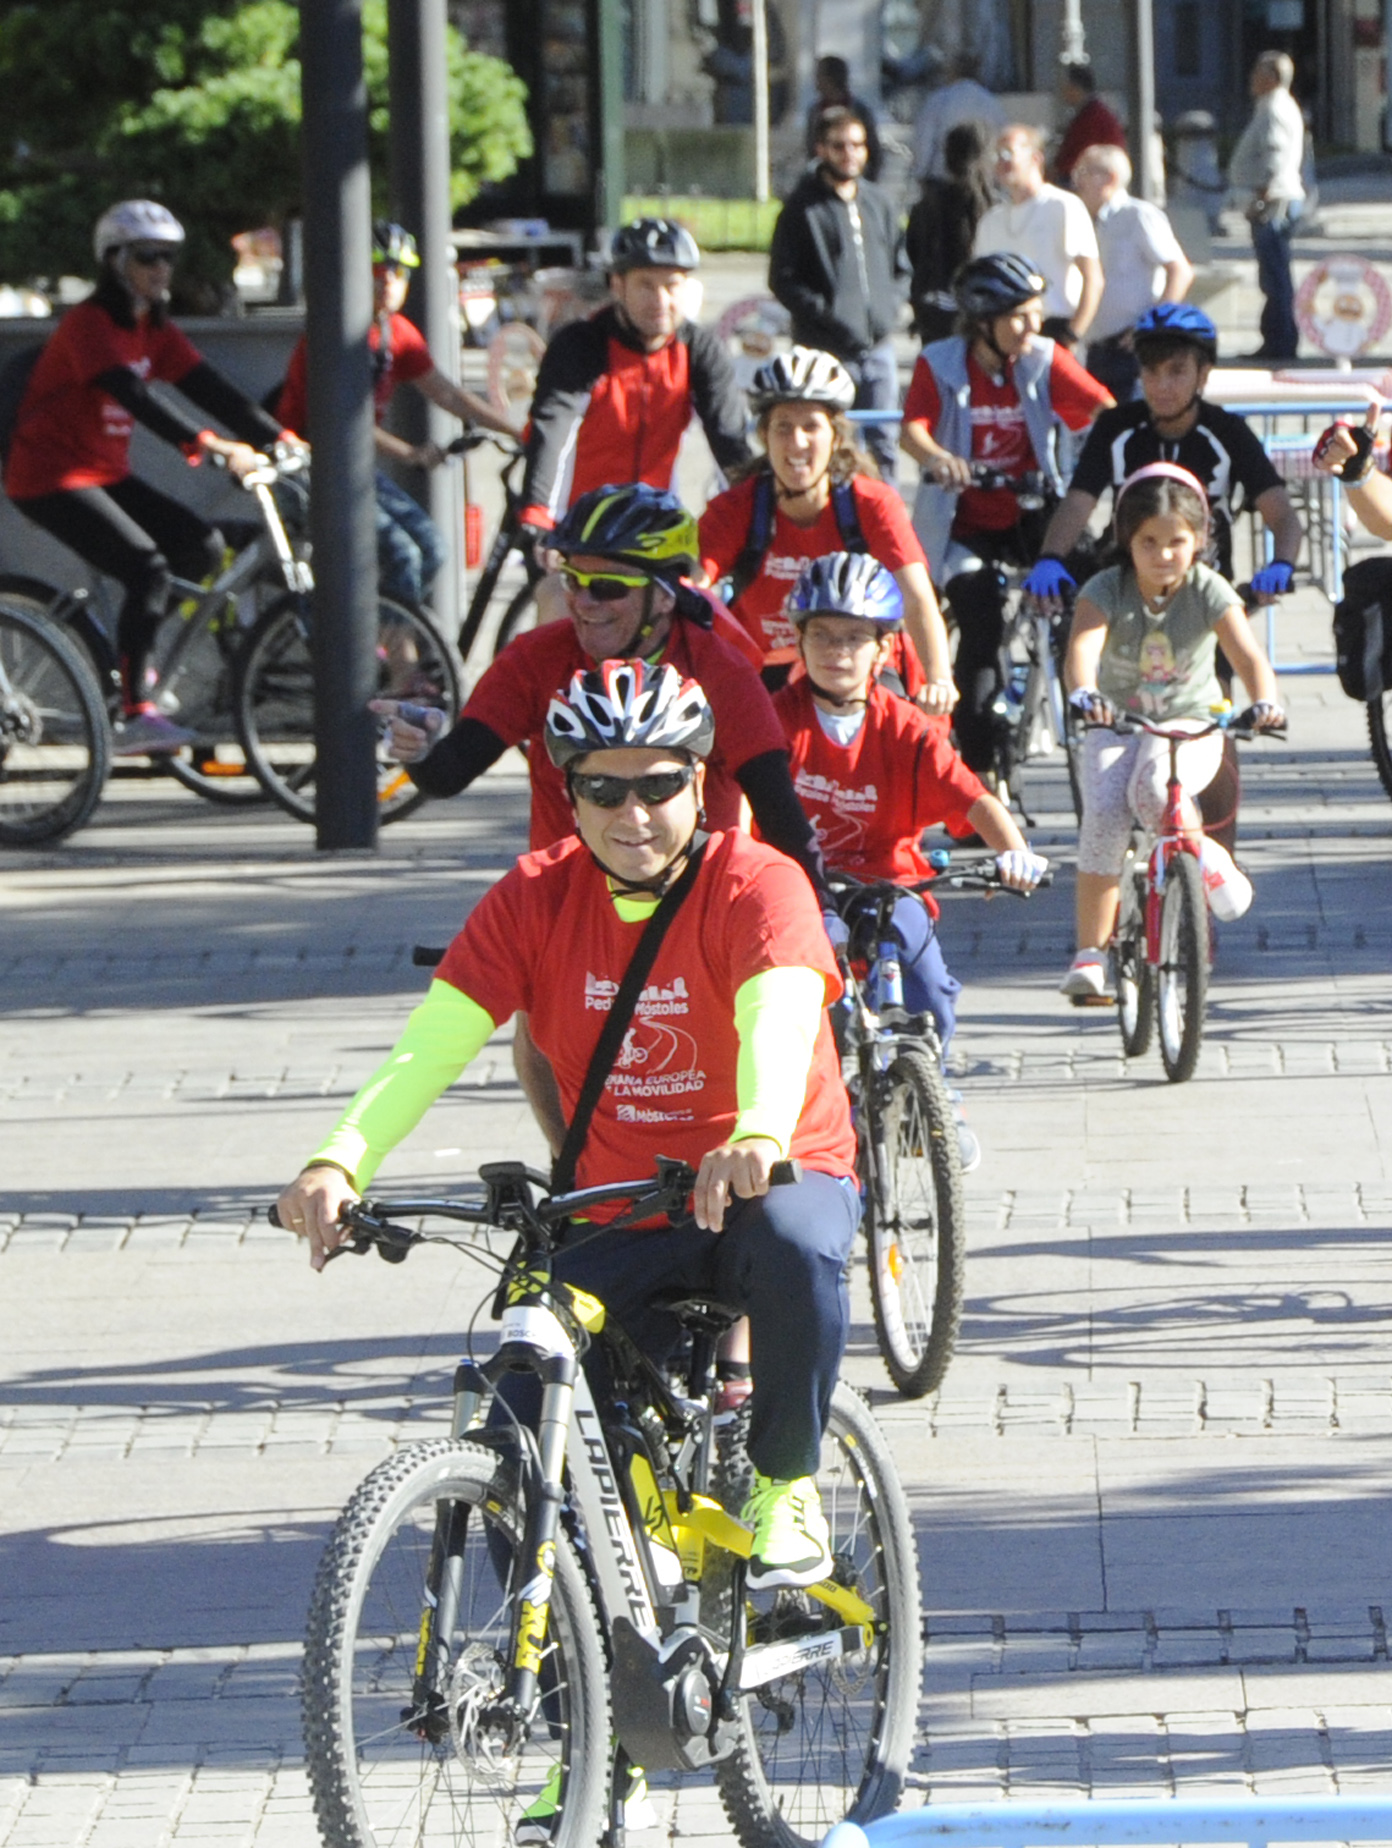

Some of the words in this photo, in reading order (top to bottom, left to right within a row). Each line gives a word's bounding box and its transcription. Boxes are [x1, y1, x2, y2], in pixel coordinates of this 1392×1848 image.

[634, 1001, 689, 1016] Móstoles
[645, 1069, 707, 1085] EUROPEA
[614, 1085, 631, 1097] LA
[632, 1080, 705, 1097] MOVILIDAD
[507, 1329, 537, 1338] BOSC
[574, 1410, 647, 1629] LAPIERRE
